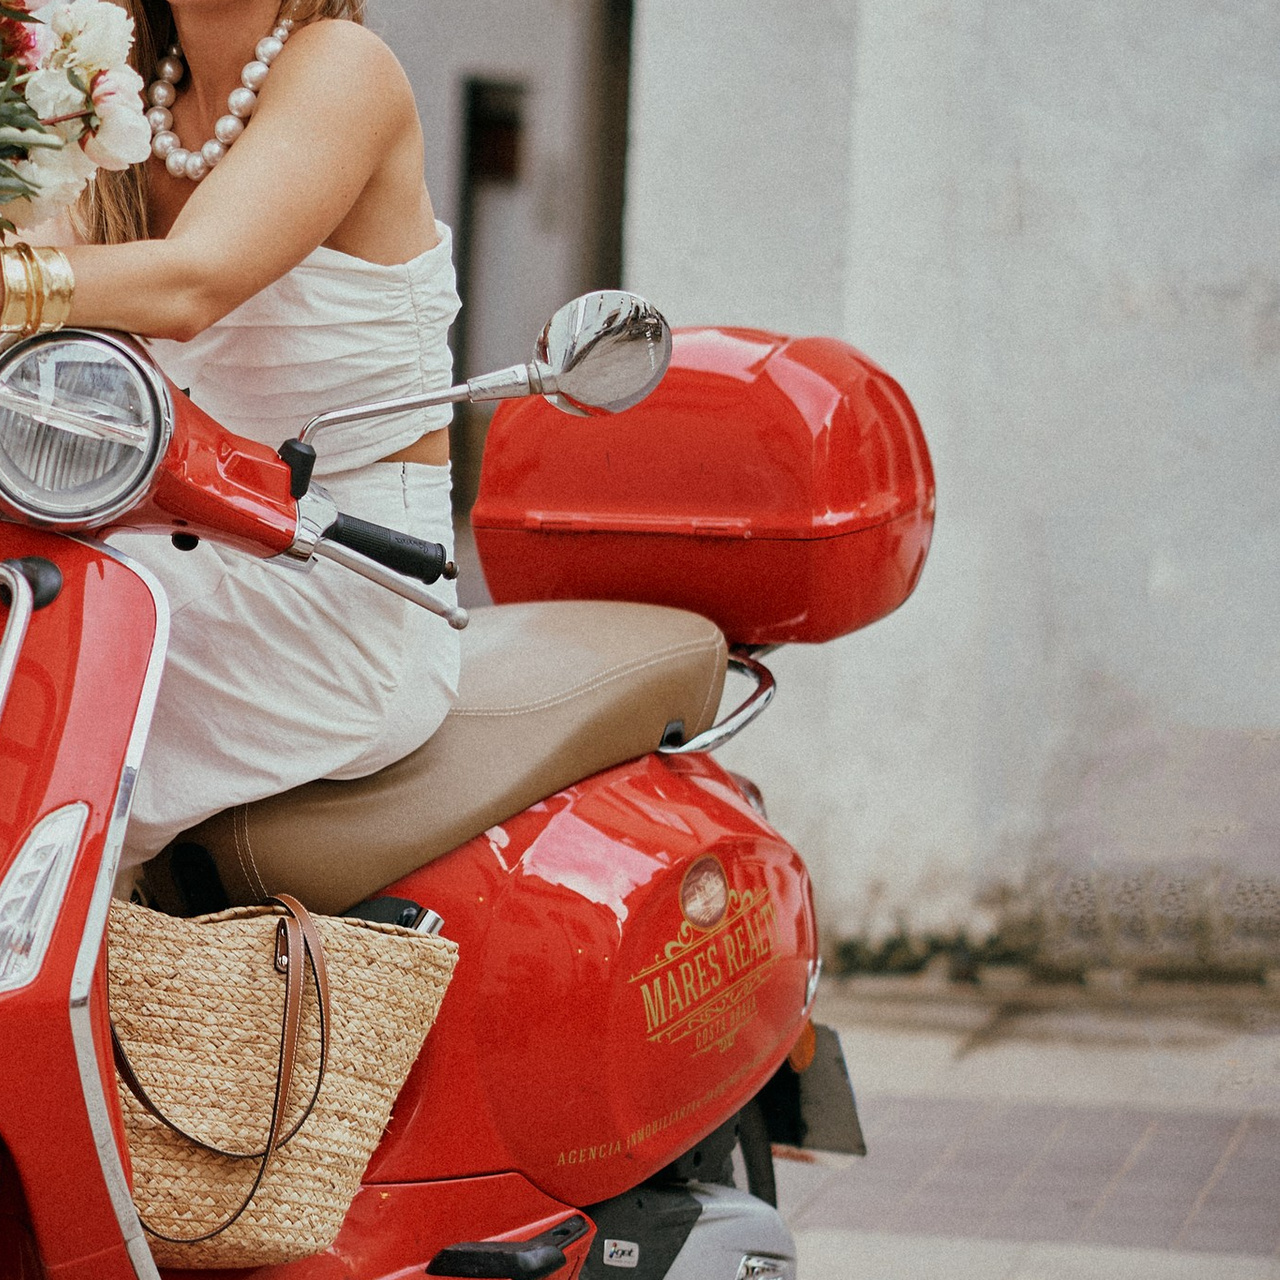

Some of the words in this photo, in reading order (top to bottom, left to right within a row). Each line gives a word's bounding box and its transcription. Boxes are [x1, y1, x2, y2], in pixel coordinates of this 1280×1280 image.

[639, 943, 722, 1034] MARES
[723, 902, 782, 977] REALTY
[556, 1140, 621, 1167] AGENCIA
